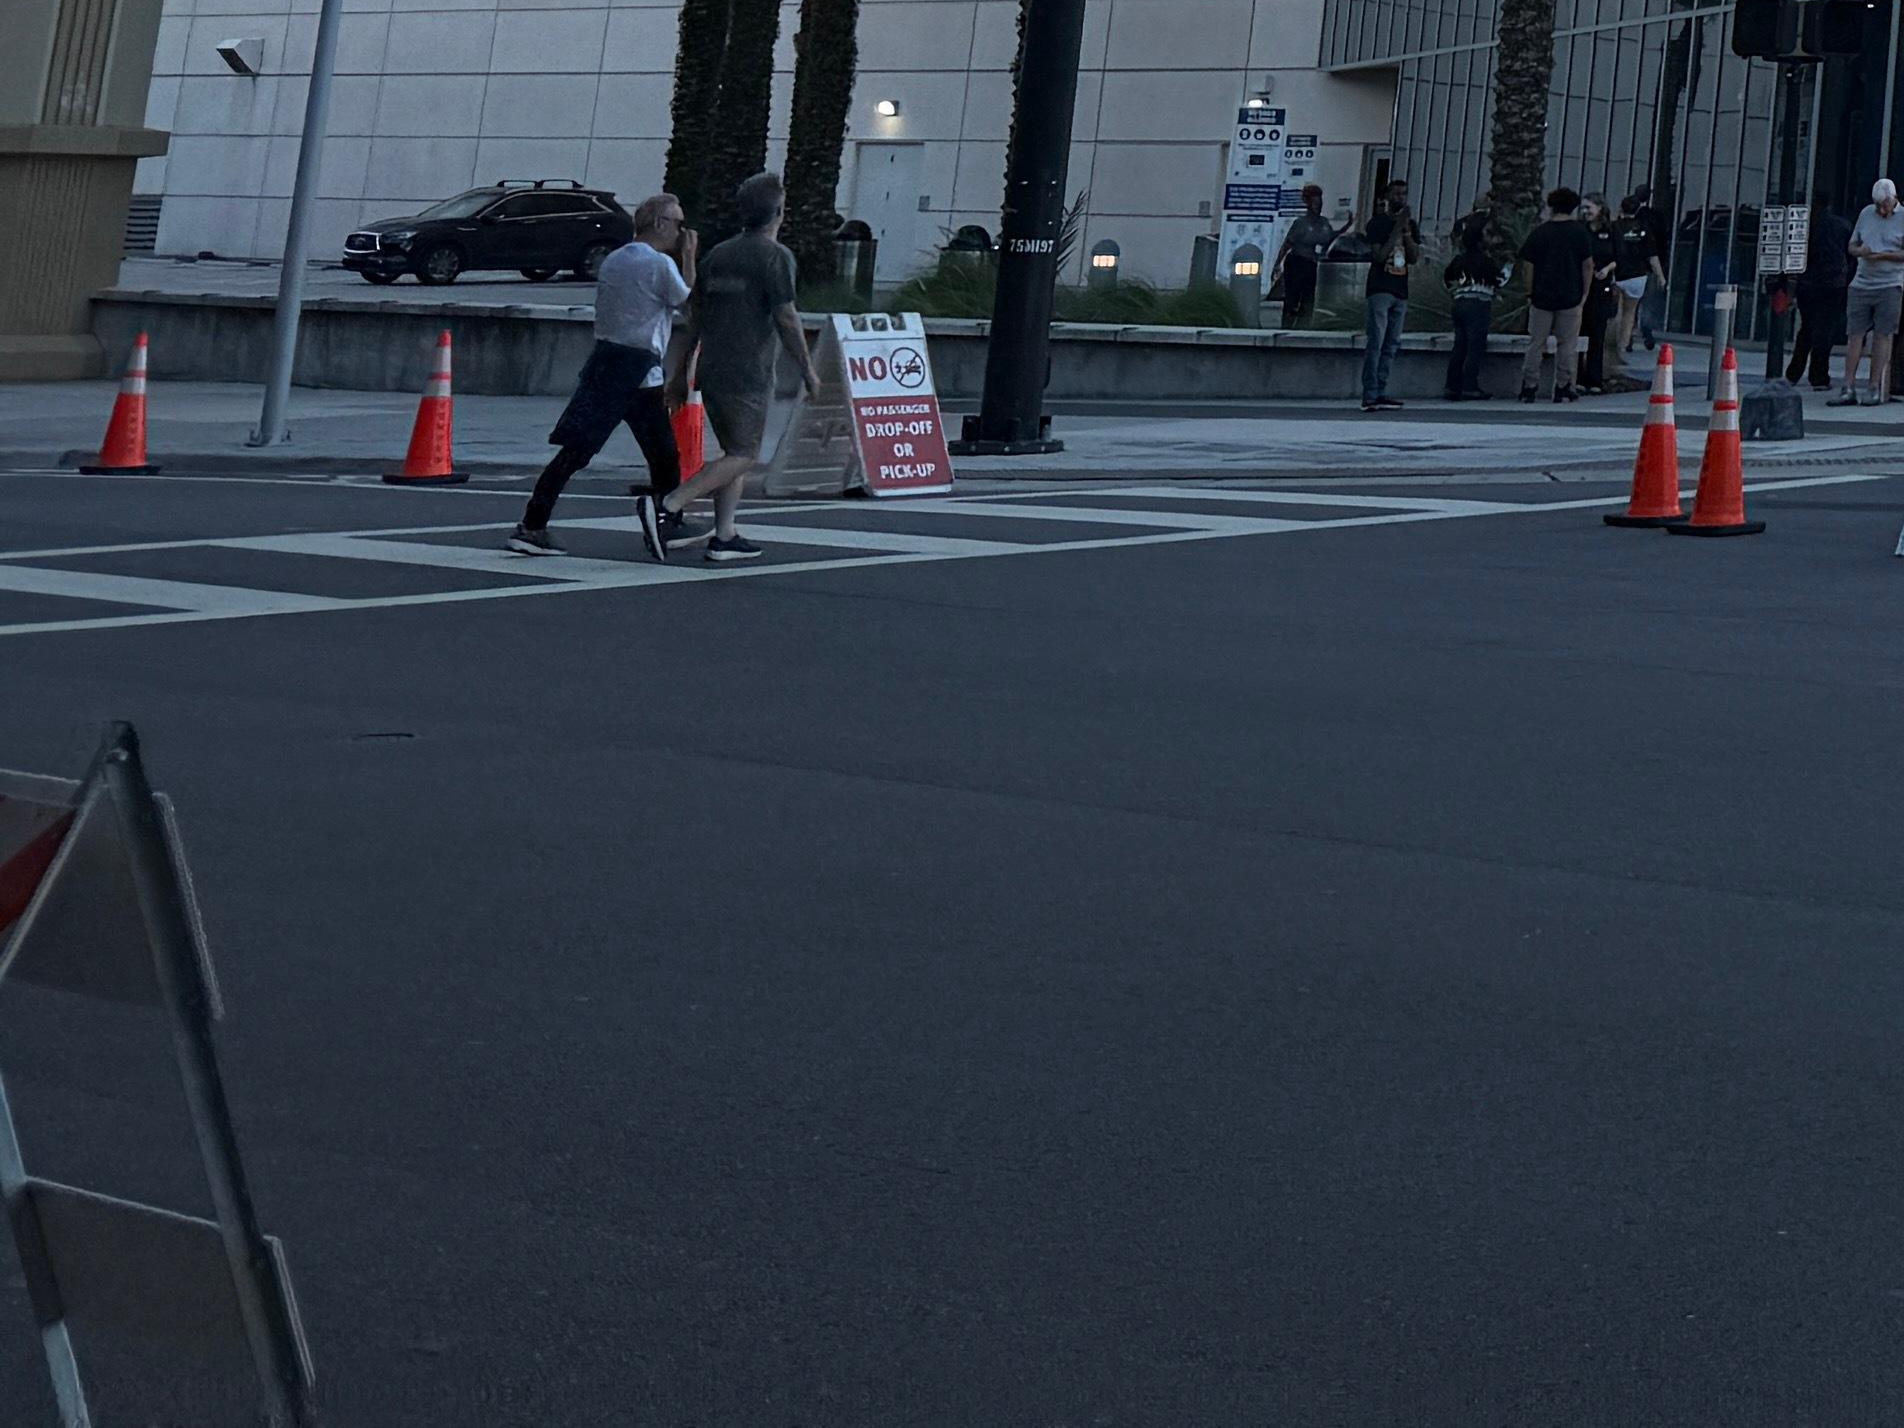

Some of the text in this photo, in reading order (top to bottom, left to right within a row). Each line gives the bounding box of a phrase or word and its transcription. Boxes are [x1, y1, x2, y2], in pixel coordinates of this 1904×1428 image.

[849, 356, 887, 382] NO
[865, 420, 933, 438] DROP-OFF
[893, 443, 915, 457] OR
[880, 462, 936, 479] PICK-UP
